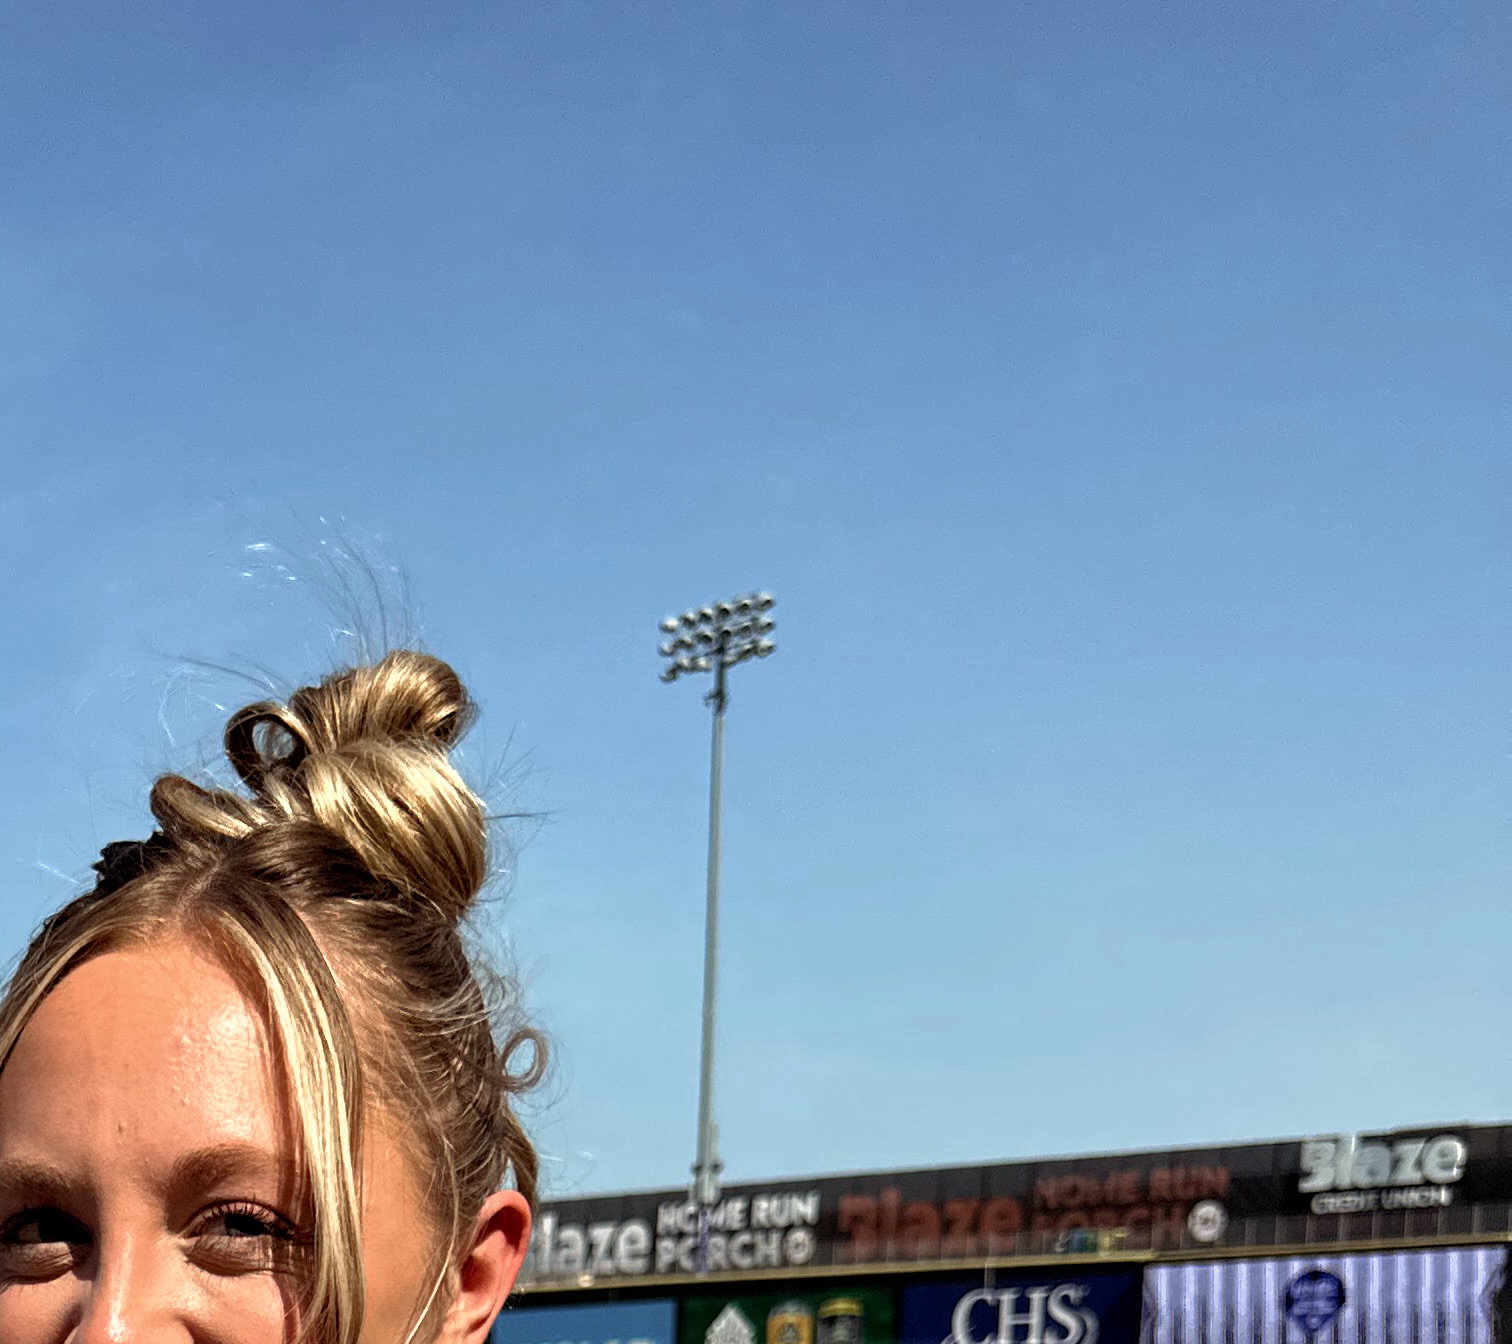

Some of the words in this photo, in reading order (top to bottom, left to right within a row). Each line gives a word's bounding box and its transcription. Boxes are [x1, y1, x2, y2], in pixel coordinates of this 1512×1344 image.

[1149, 1166, 1230, 1199] RUN
[1298, 1134, 1467, 1193] Blaze
[750, 1189, 821, 1228] RUN
[1380, 1186, 1452, 1210] UNION
[528, 1213, 654, 1276] laze
[838, 1187, 1023, 1263] Blaze
[655, 1226, 785, 1274] PORCH
